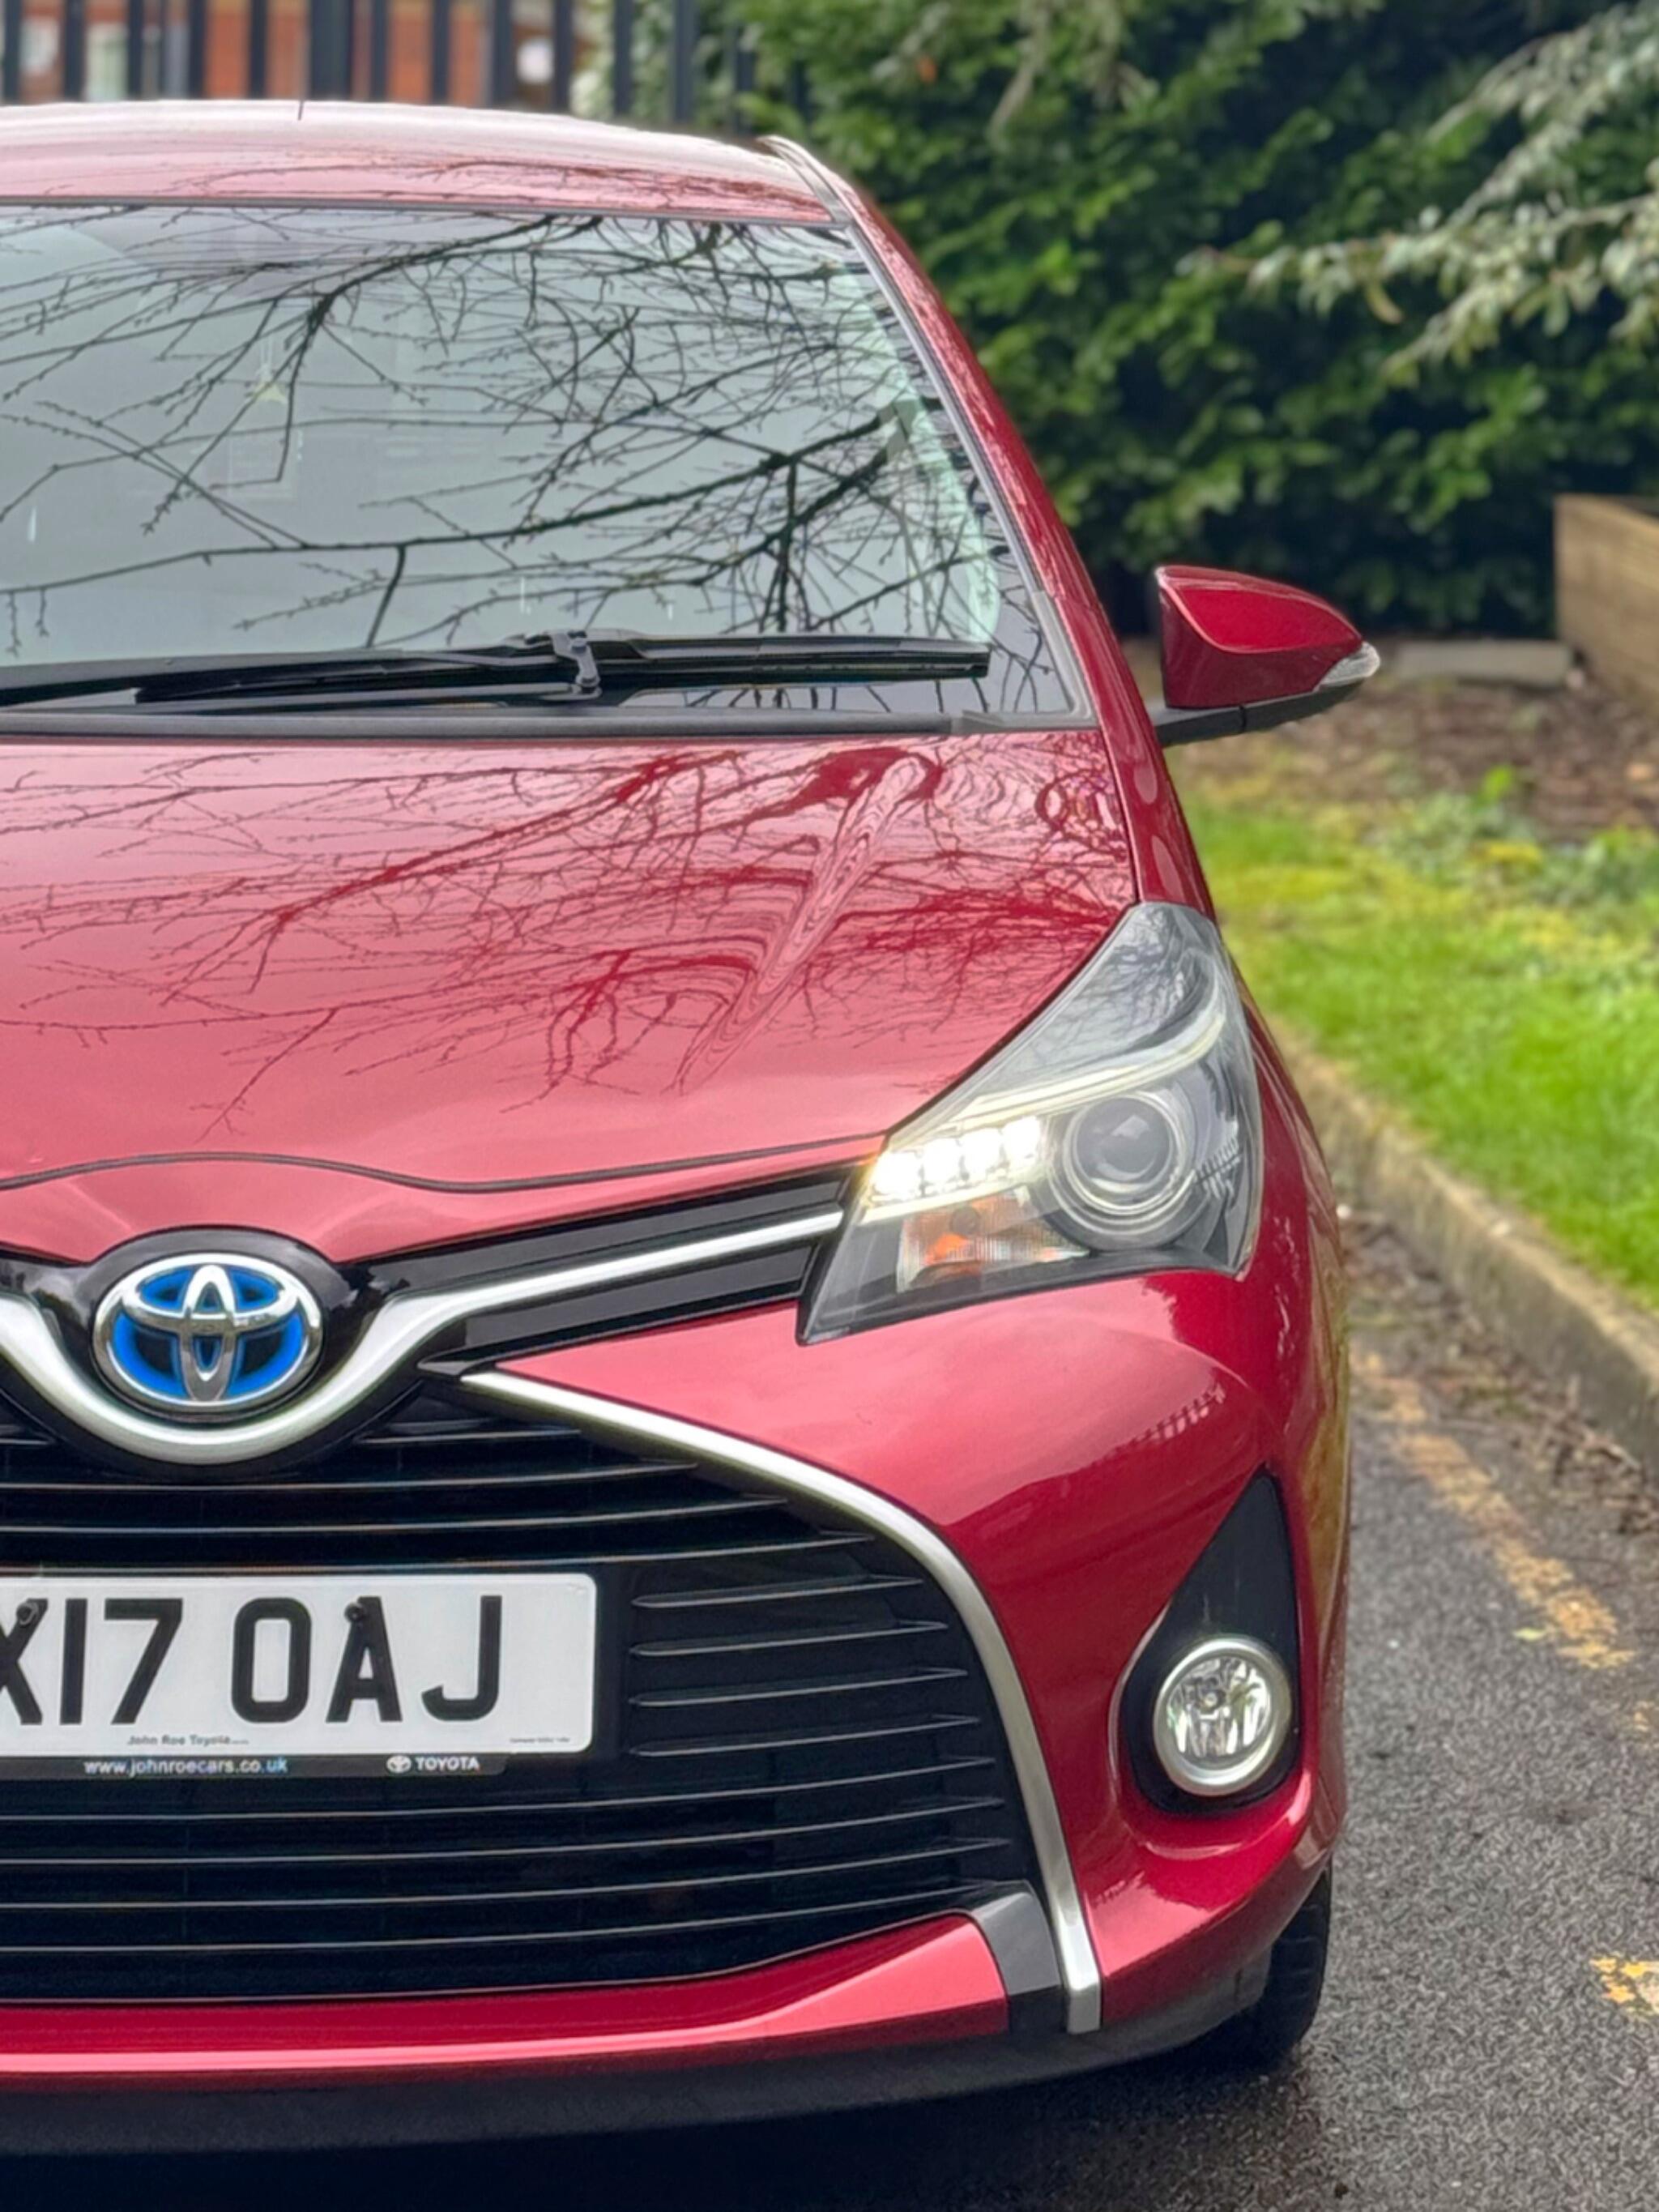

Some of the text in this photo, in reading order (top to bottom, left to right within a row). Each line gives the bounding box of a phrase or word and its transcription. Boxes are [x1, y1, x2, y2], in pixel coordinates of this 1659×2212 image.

[231, 1595, 503, 1724] OAJ
[127, 1735, 158, 1745] John
[83, 1758, 288, 1778] www.johnroecars.co.uk
[415, 1757, 480, 1772] TOYOTA
